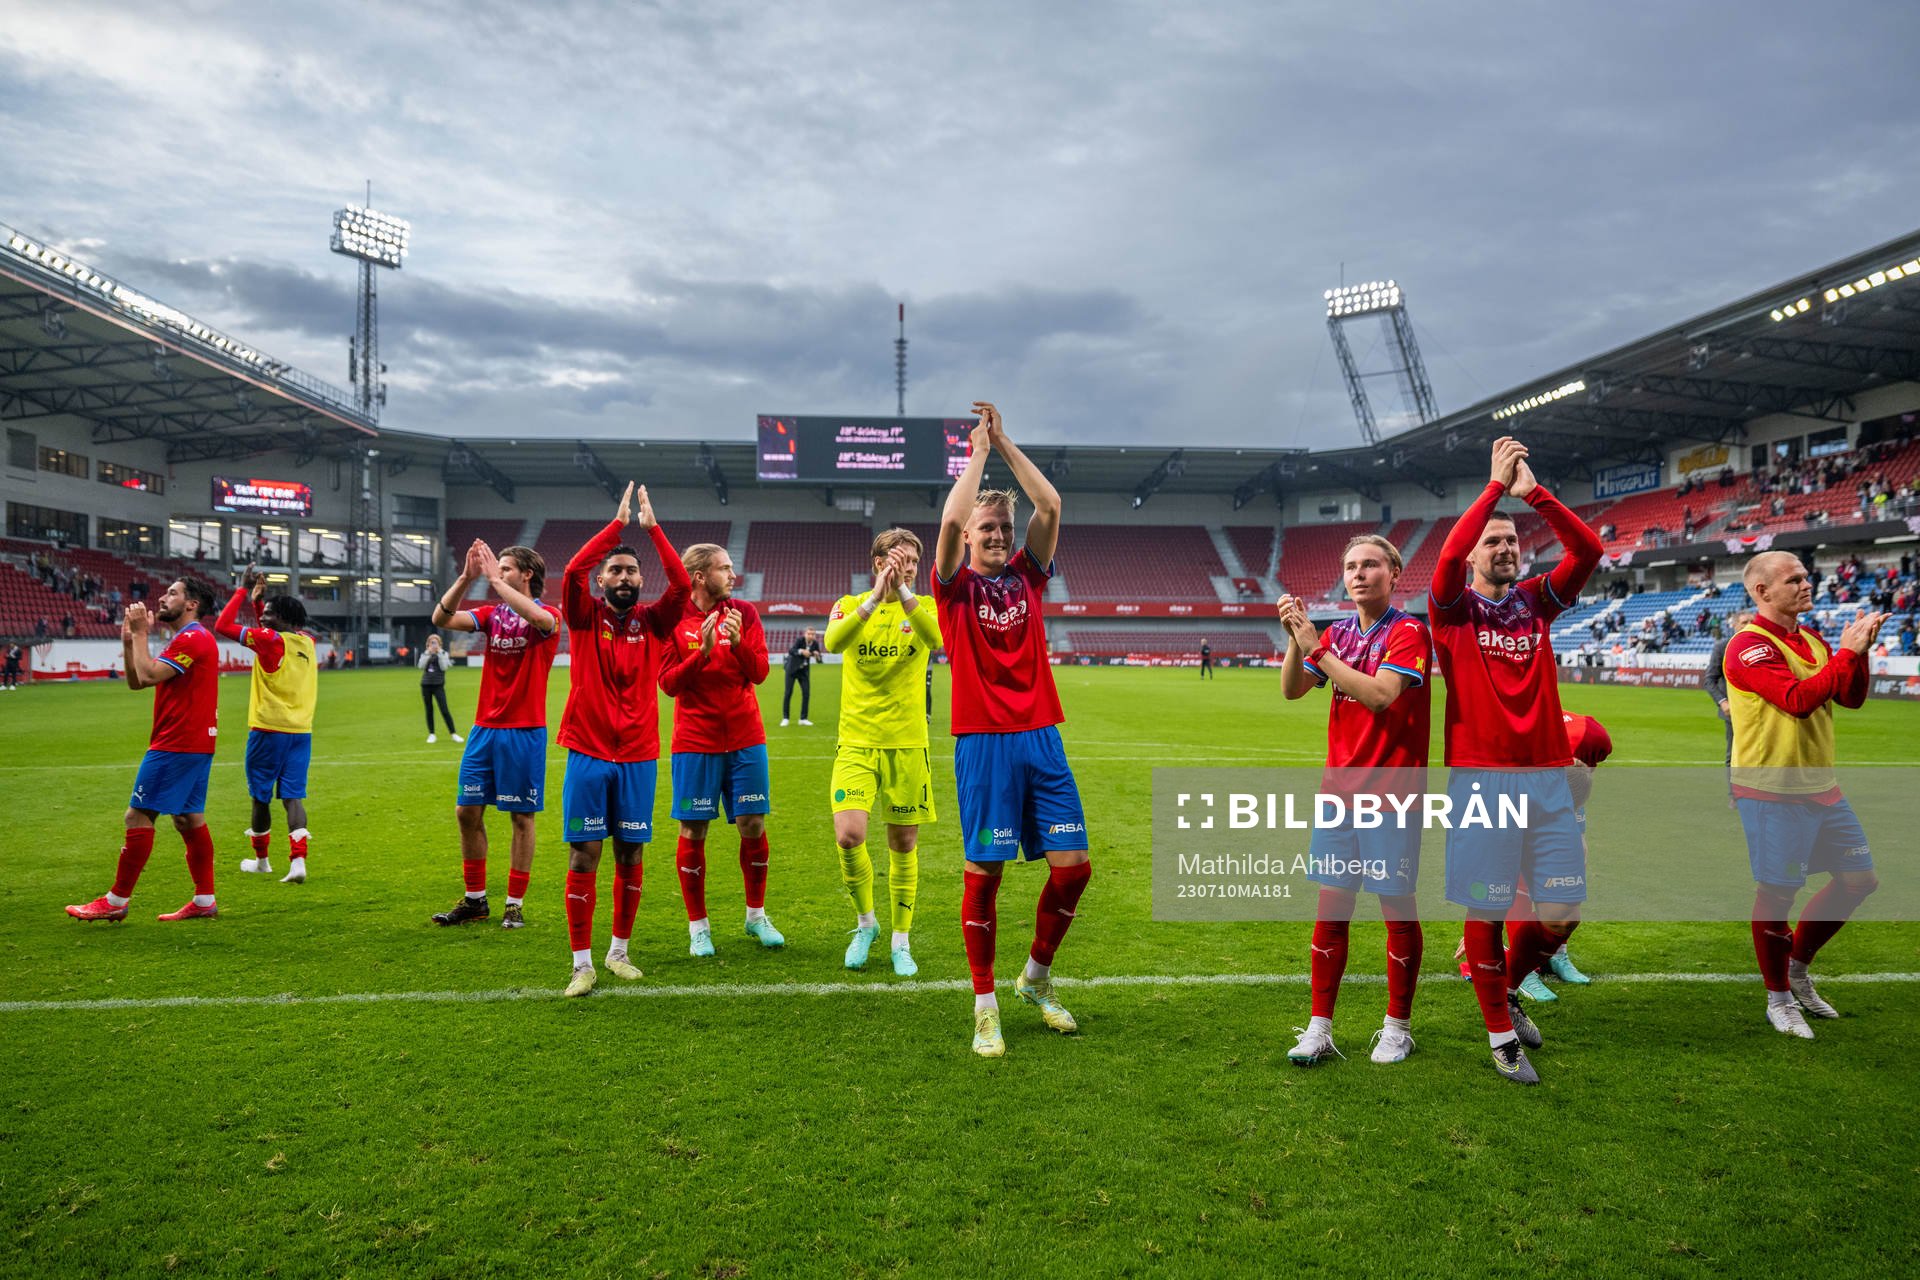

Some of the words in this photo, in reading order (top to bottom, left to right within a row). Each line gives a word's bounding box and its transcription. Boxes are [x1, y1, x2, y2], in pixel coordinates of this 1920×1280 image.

[979, 603, 1018, 625] akea
[1478, 630, 1530, 651] akea
[858, 641, 898, 657] akea
[846, 788, 865, 797] Solid
[922, 783, 928, 802] 1
[693, 798, 711, 806] Solid
[742, 794, 766, 802] RSA
[584, 817, 604, 825] Solid
[622, 821, 648, 830] RSA
[993, 828, 1012, 838] Solid
[1055, 823, 1084, 834] RSA
[1400, 858, 1410, 869] 22
[1552, 876, 1584, 887] RSA
[1488, 884, 1511, 894] Solid
